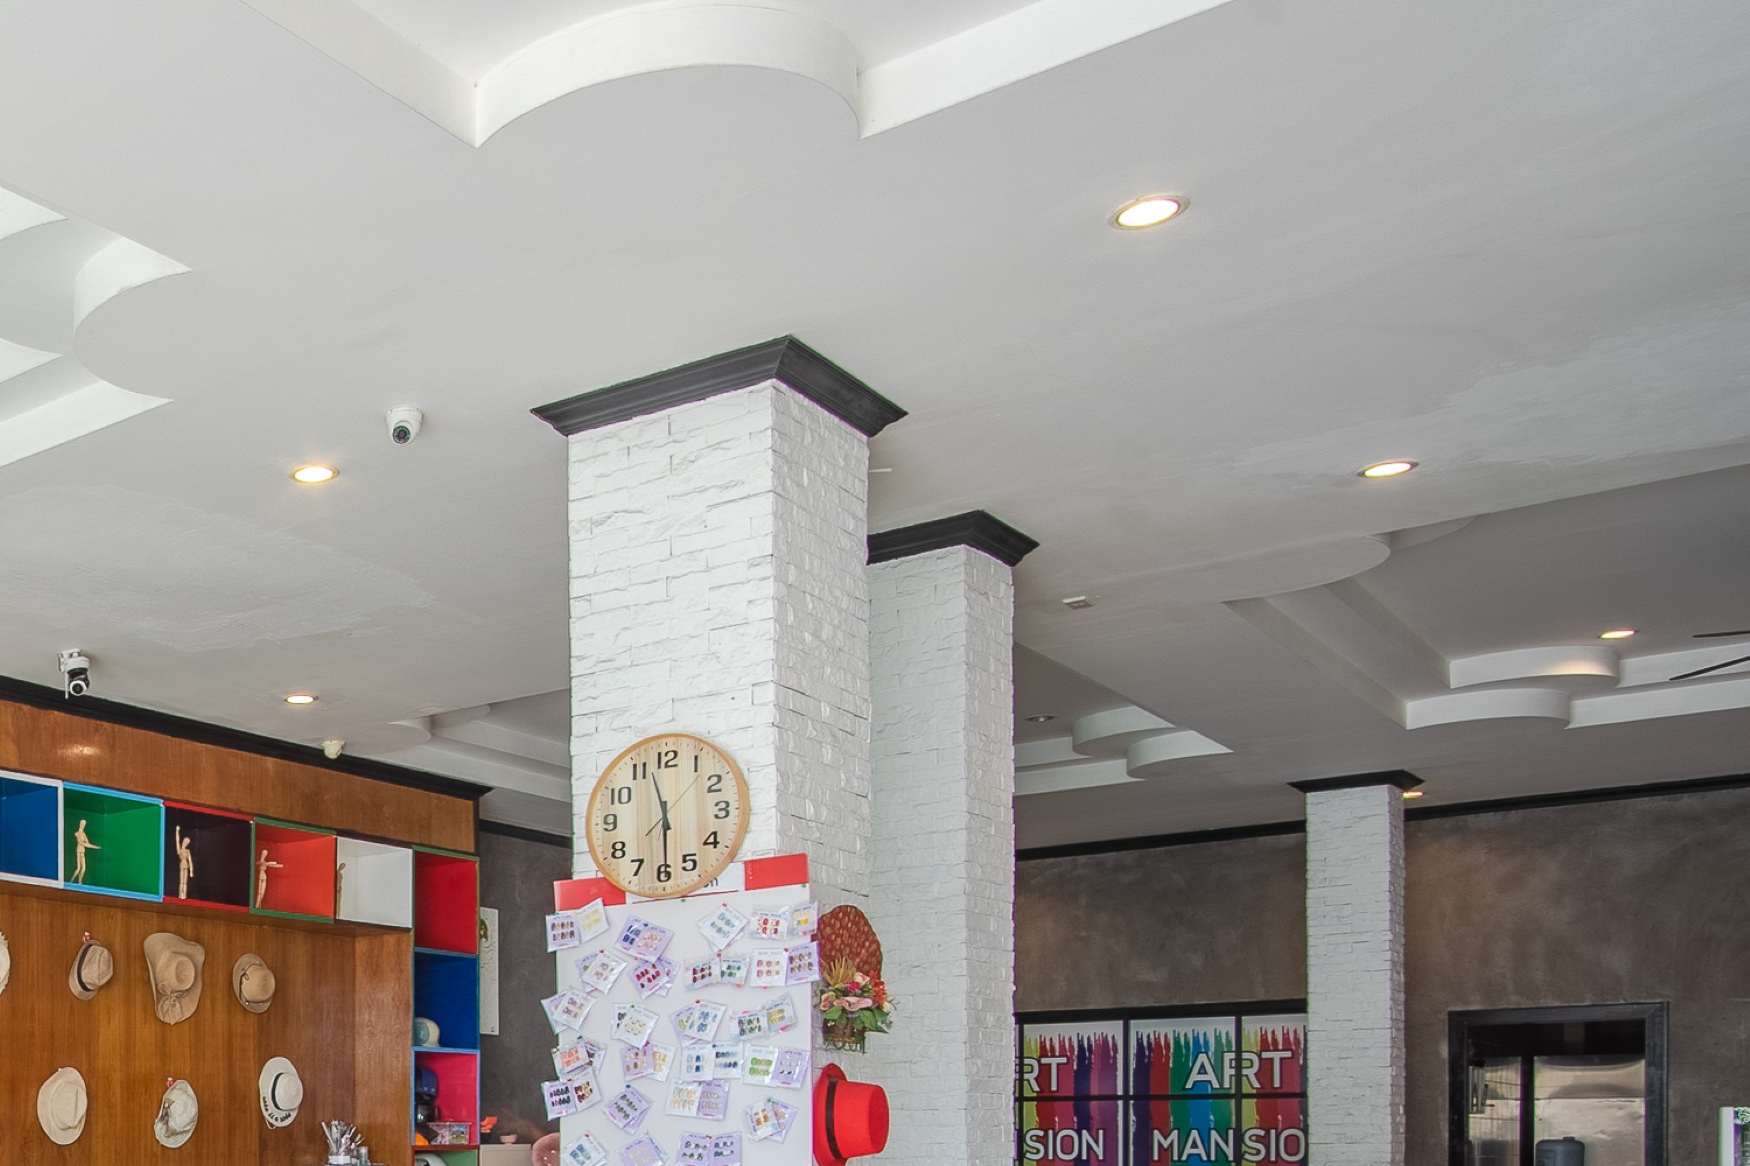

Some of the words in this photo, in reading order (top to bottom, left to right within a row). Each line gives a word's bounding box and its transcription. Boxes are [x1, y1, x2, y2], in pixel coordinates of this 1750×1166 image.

[657, 750, 679, 769] 12
[693, 755, 698, 772] 1
[632, 762, 646, 780] 11
[707, 774, 722, 793] 2
[610, 786, 631, 805] 10
[714, 800, 730, 819] 3
[603, 813, 618, 831] 9
[611, 841, 626, 858] 8
[702, 831, 720, 849] 4
[630, 858, 645, 877] 7
[681, 853, 697, 872] 5
[1184, 1051, 1293, 1090] ART
